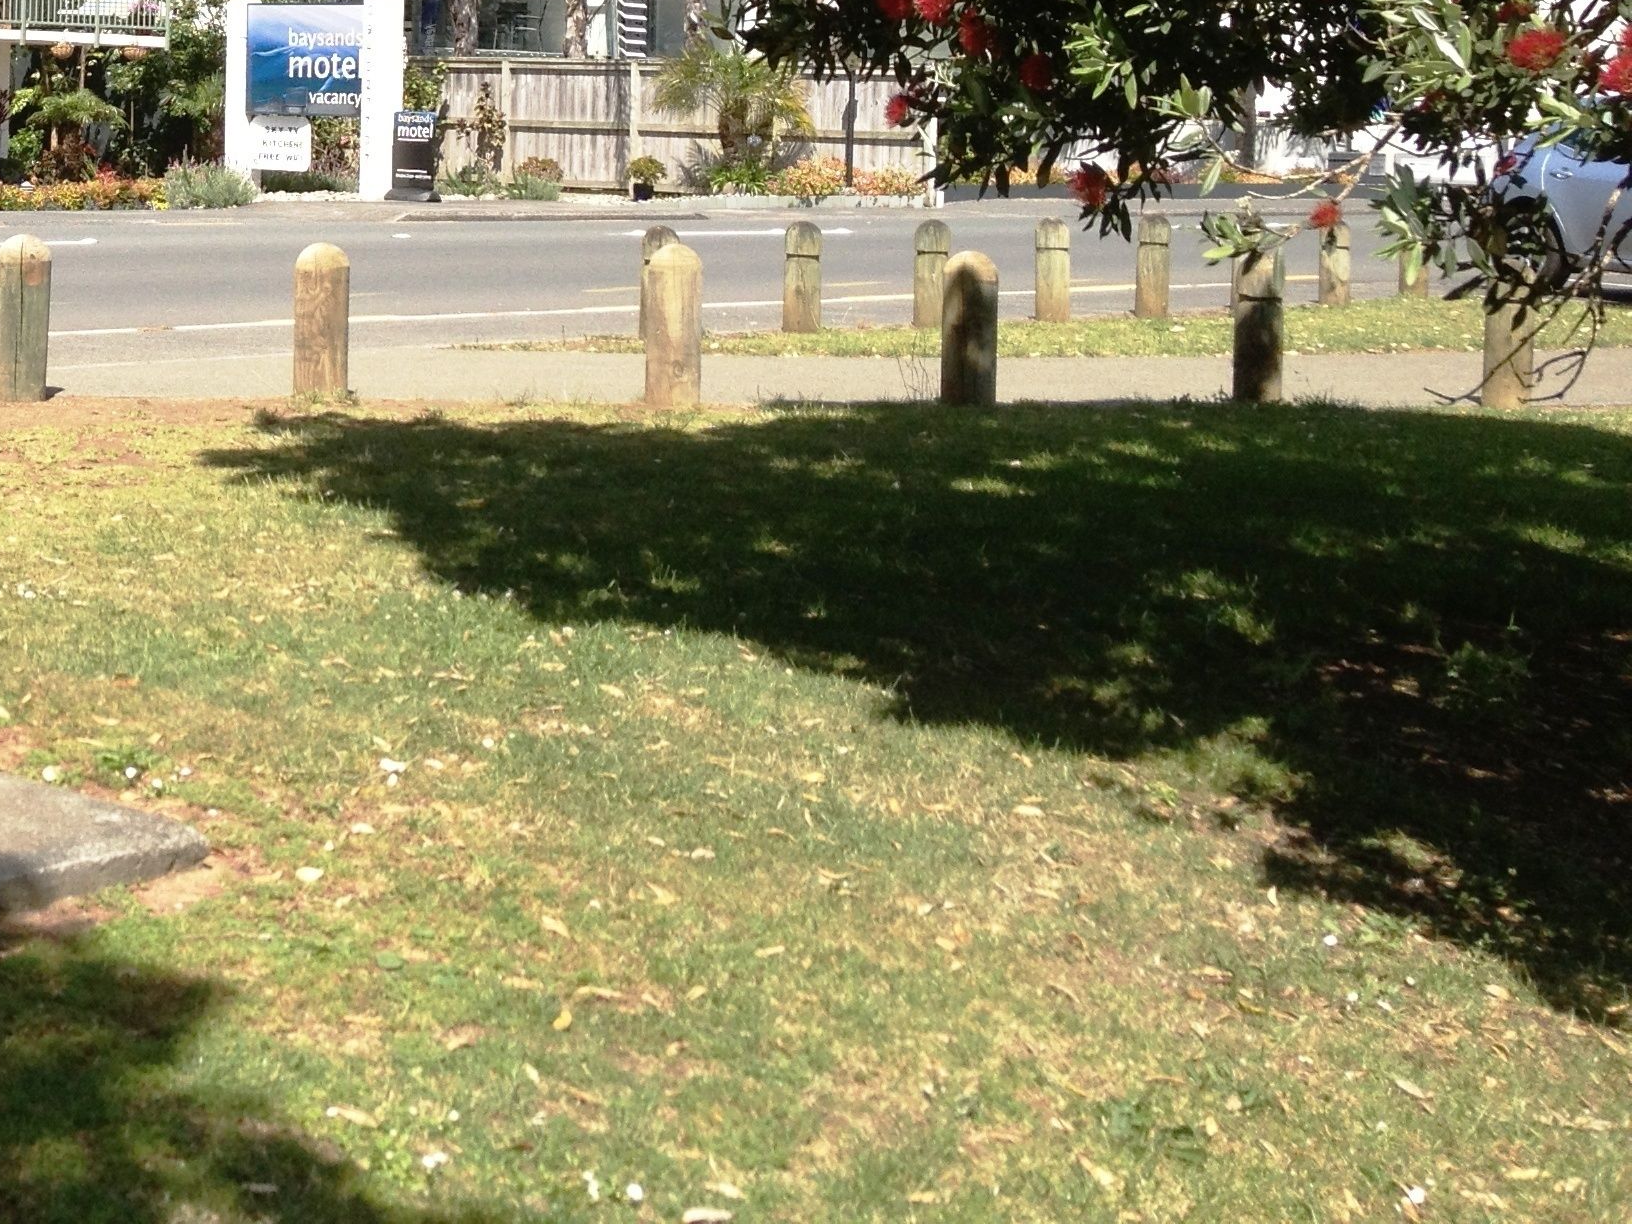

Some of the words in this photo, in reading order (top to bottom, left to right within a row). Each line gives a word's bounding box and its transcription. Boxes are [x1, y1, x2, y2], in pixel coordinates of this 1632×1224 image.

[288, 26, 363, 50] baysands
[288, 48, 363, 80] motel
[308, 91, 362, 108] vacancy
[397, 122, 434, 138] motel
